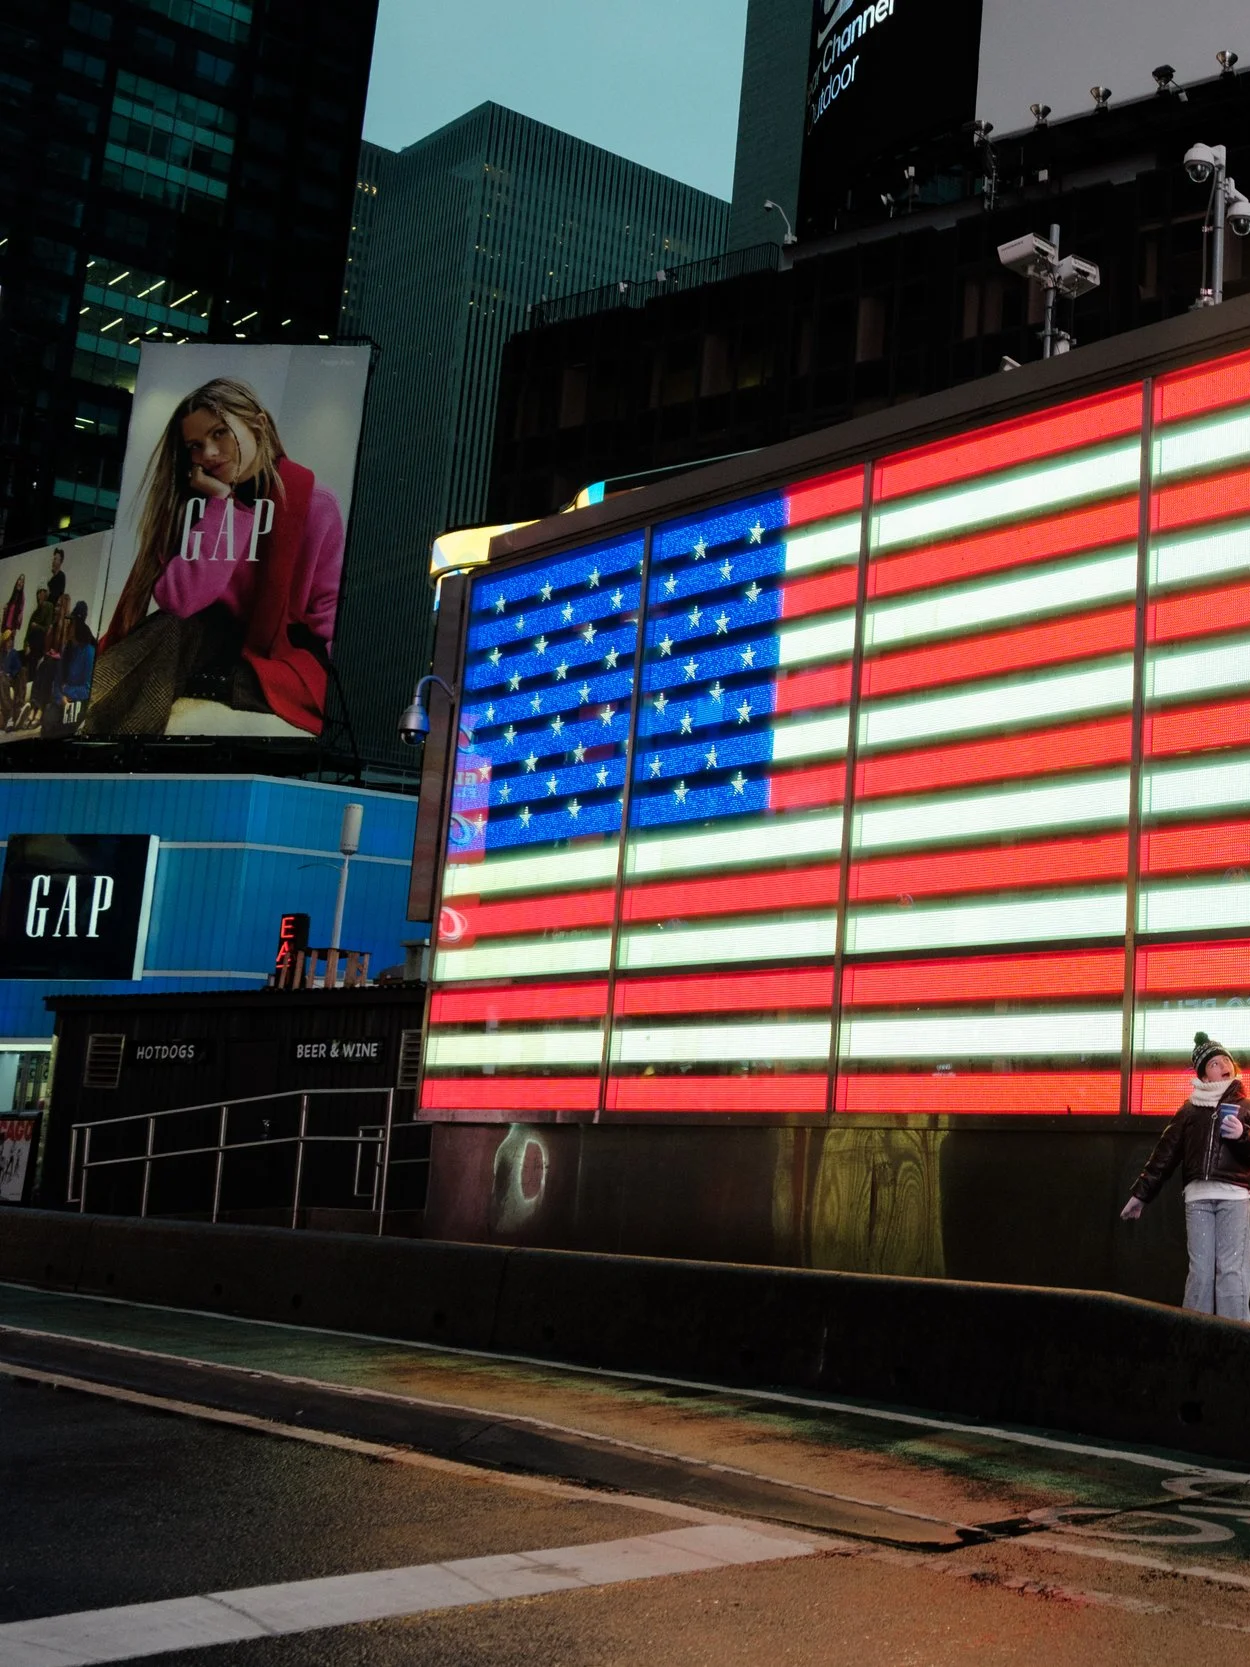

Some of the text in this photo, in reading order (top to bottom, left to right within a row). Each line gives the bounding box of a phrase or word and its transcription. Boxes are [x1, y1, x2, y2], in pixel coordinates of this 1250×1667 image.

[180, 497, 275, 562] GAP
[62, 701, 82, 724] GAP
[25, 874, 114, 938] GAP
[136, 1044, 195, 1060] HOTDOGS
[296, 1042, 378, 1059] BEER & WINE
